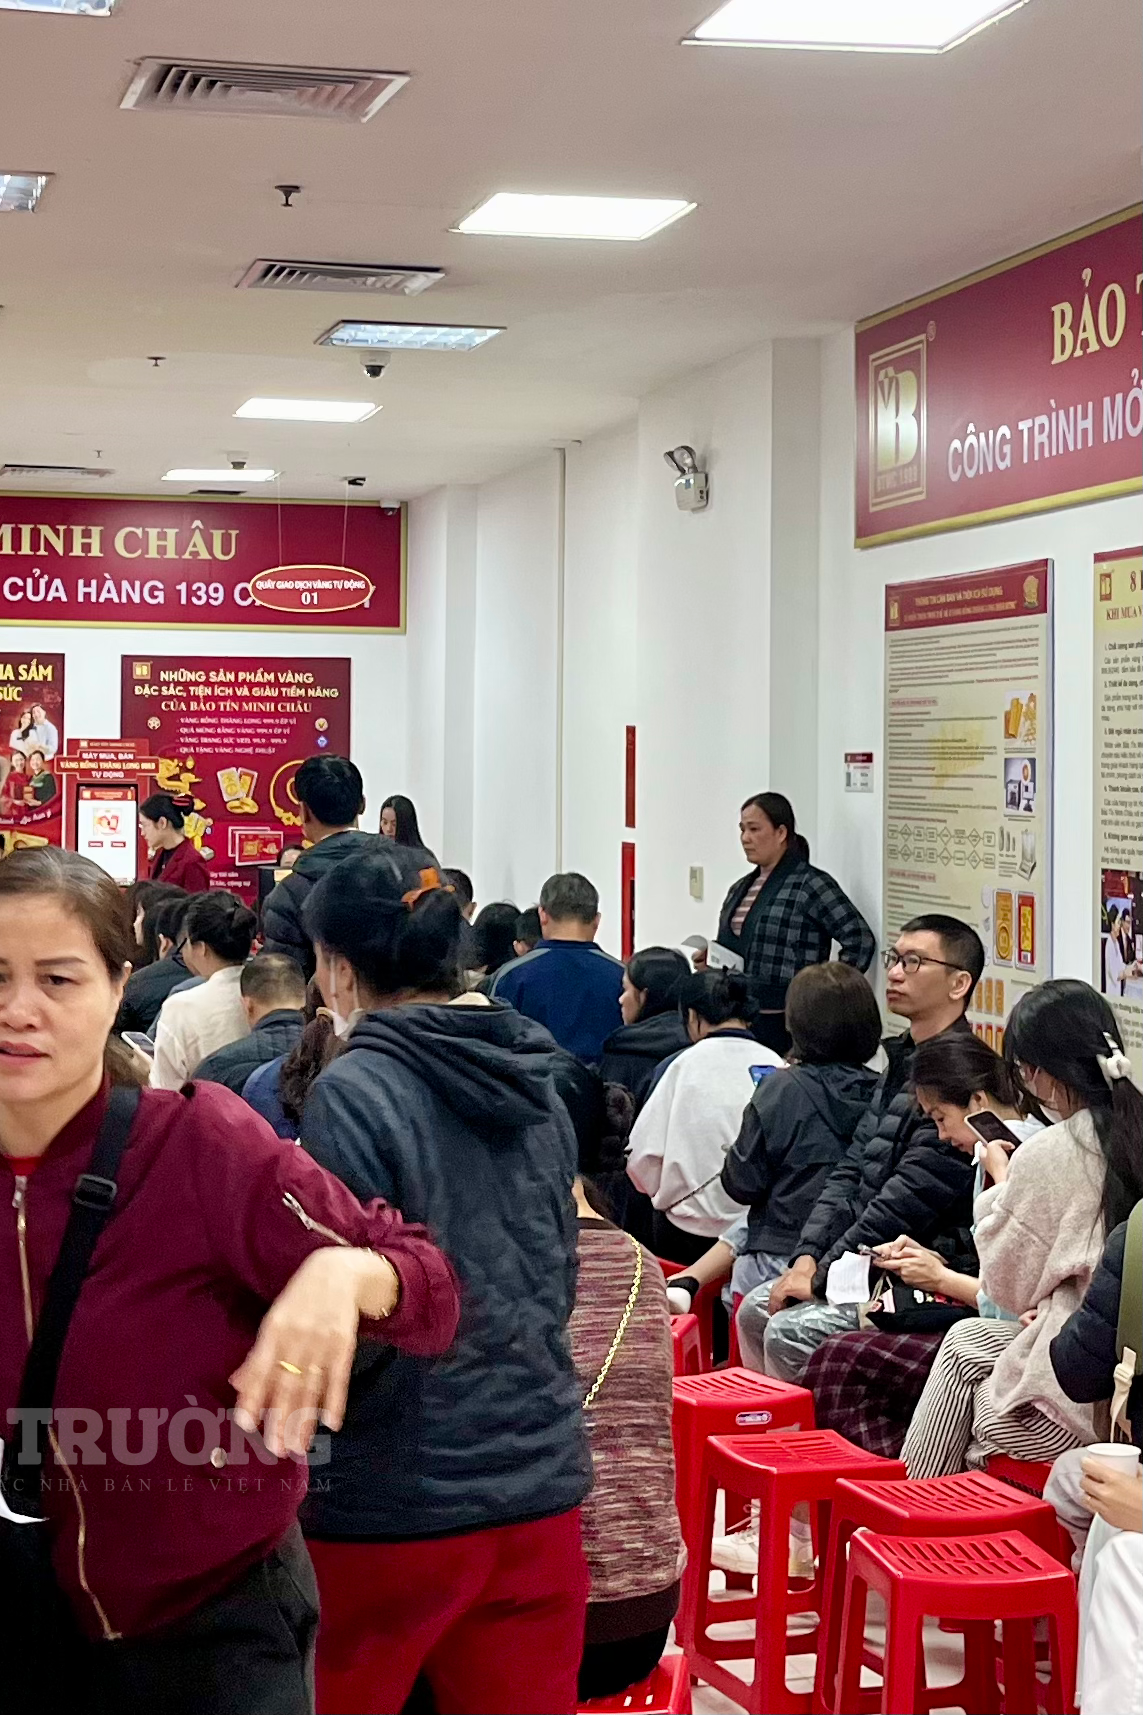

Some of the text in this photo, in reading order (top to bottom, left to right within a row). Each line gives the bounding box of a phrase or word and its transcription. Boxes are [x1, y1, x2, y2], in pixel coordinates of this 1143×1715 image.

[1051, 267, 1126, 365] BẢO
[948, 422, 1011, 482] CÔNG
[1018, 399, 1093, 464] TRÌNH
[114, 520, 239, 560] CHÂU
[3, 568, 67, 602] CỬA
[78, 573, 165, 605] HÀNG
[175, 581, 224, 606] 139
[301, 592, 318, 605] 01
[160, 667, 314, 684] NHỮNG SẢN PHẨM VÀNG
[134, 683, 158, 698] ĐẶC
[161, 683, 186, 698] SẮC,
[189, 685, 212, 698] TIỆN
[214, 685, 232, 697] ÍCH
[235, 685, 250, 697] VÀ
[252, 685, 278, 697] GIÀU
[307, 686, 339, 698] NĂNG
[161, 697, 312, 713] CỦA BẢO TÍN MINH CHÂU
